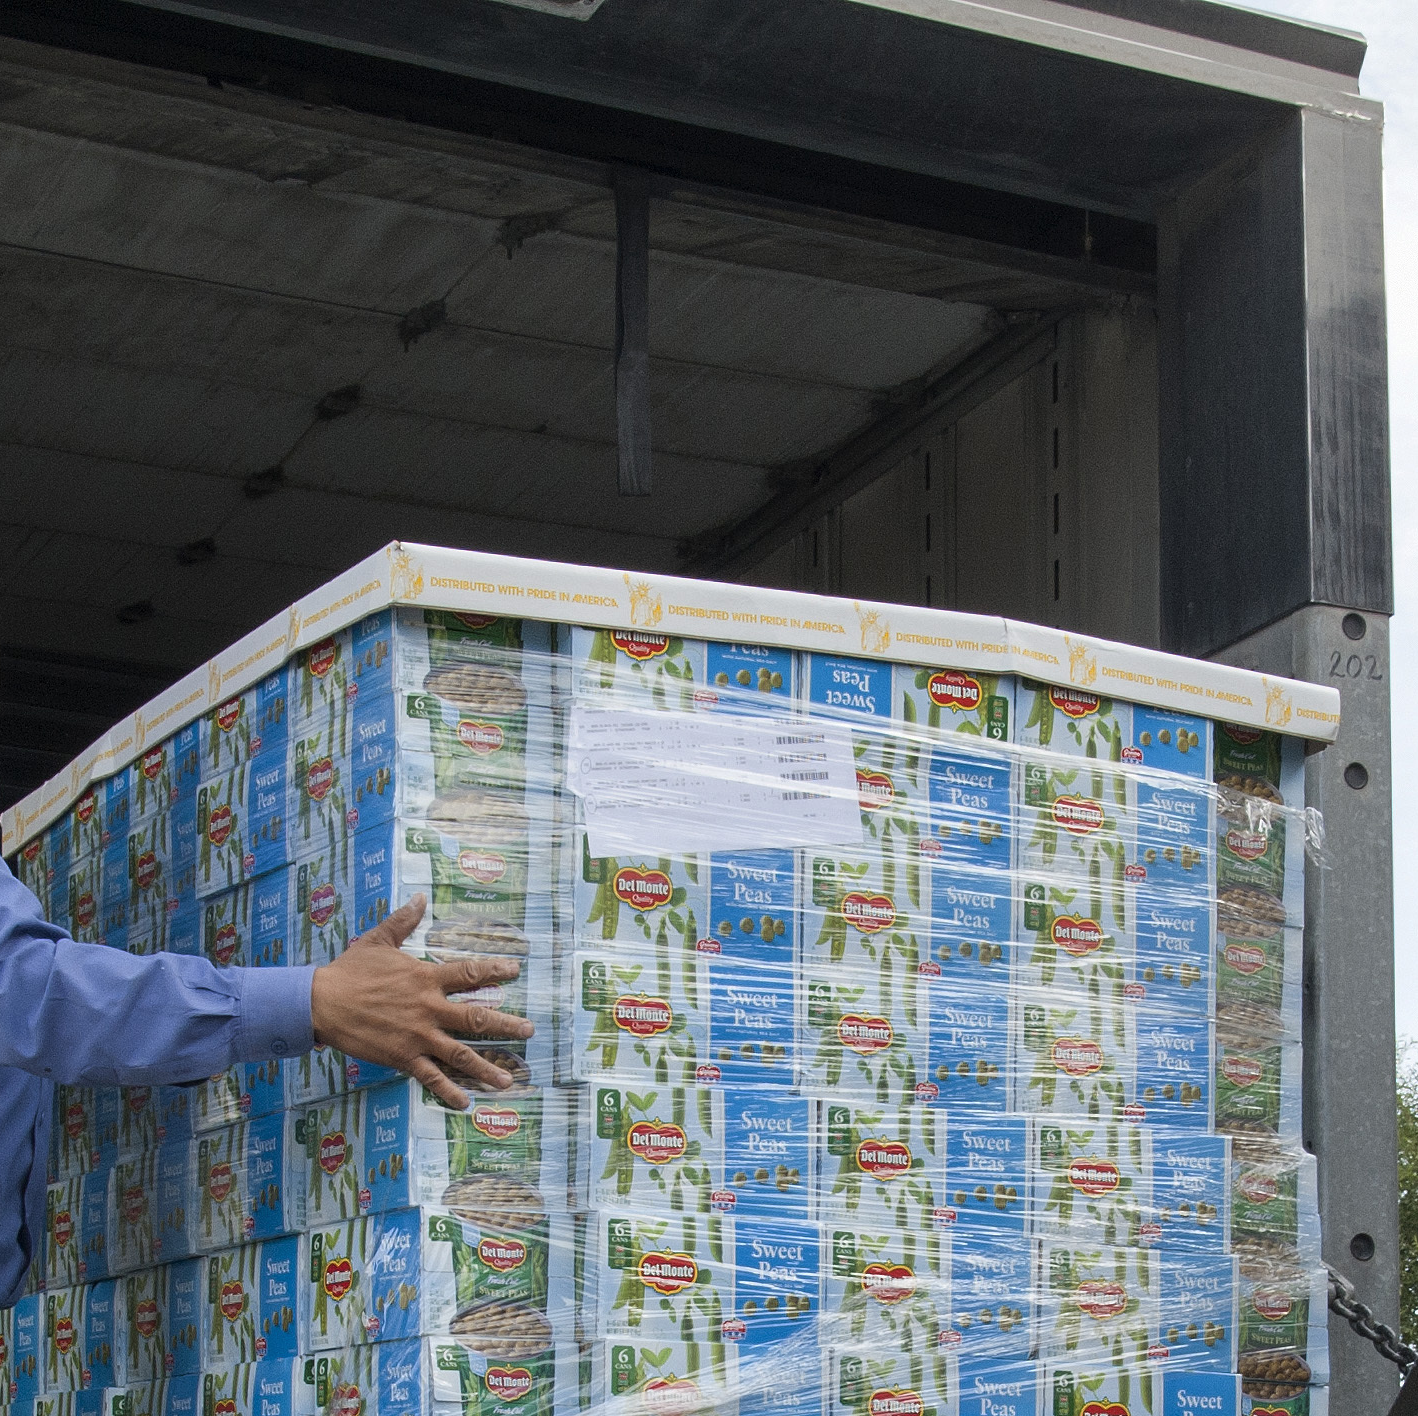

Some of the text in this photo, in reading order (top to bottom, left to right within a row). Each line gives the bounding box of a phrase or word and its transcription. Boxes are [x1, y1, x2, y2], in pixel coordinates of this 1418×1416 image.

[430, 576, 619, 608] DISTRIBUTED WITH PRIDE IN AMERICA
[668, 605, 846, 634] DISTRIBUTED WITH PRIDE IN AMERICA
[896, 633, 1059, 665] DISTRIBUTED WITH PRIDE IN AMERICA
[1329, 650, 1382, 680] 202
[833, 670, 870, 690] Peas
[1102, 666, 1253, 707] DISTRIBUTED WITH PRIDE IN AMERICA
[414, 696, 426, 711] 6
[826, 690, 875, 712] Sweet
[1296, 707, 1340, 724] DISTRIBUT
[358, 720, 386, 740] Sweet
[361, 744, 383, 762] Peas
[255, 772, 279, 790] Sweet
[944, 766, 993, 787] Sweet
[257, 793, 276, 811] Peas
[951, 788, 988, 809] Peas
[413, 830, 424, 845] 6
[362, 848, 386, 868] Sweet
[364, 872, 383, 891] Peas
[728, 862, 776, 882] Sweet
[734, 882, 773, 904] Peas
[946, 888, 995, 908] Sweet
[954, 909, 989, 929] Peas
[1151, 911, 1195, 932] Sweet
[1156, 932, 1190, 951] Peas
[588, 963, 601, 978] 6
[728, 988, 777, 1008] Sweet
[733, 1008, 773, 1028] Peas
[603, 1092, 614, 1107] 6
[742, 1111, 792, 1132] Sweet
[748, 1133, 787, 1153] Peas
[962, 1131, 1010, 1151] Sweet
[969, 1153, 1004, 1172] Peas
[434, 1216, 446, 1231] 6
[752, 1240, 803, 1260] Sweet
[266, 1259, 290, 1277] Sweet
[759, 1260, 797, 1281] Peas
[268, 1279, 286, 1296] Peas
[443, 1347, 454, 1361] 6
[618, 1347, 628, 1363] 6
[259, 1379, 284, 1398] Sweet
[975, 1378, 1022, 1397] Sweet
[261, 1399, 281, 1416] Peas
[981, 1398, 1017, 1416] Peas
[1177, 1390, 1222, 1409] Sweet
